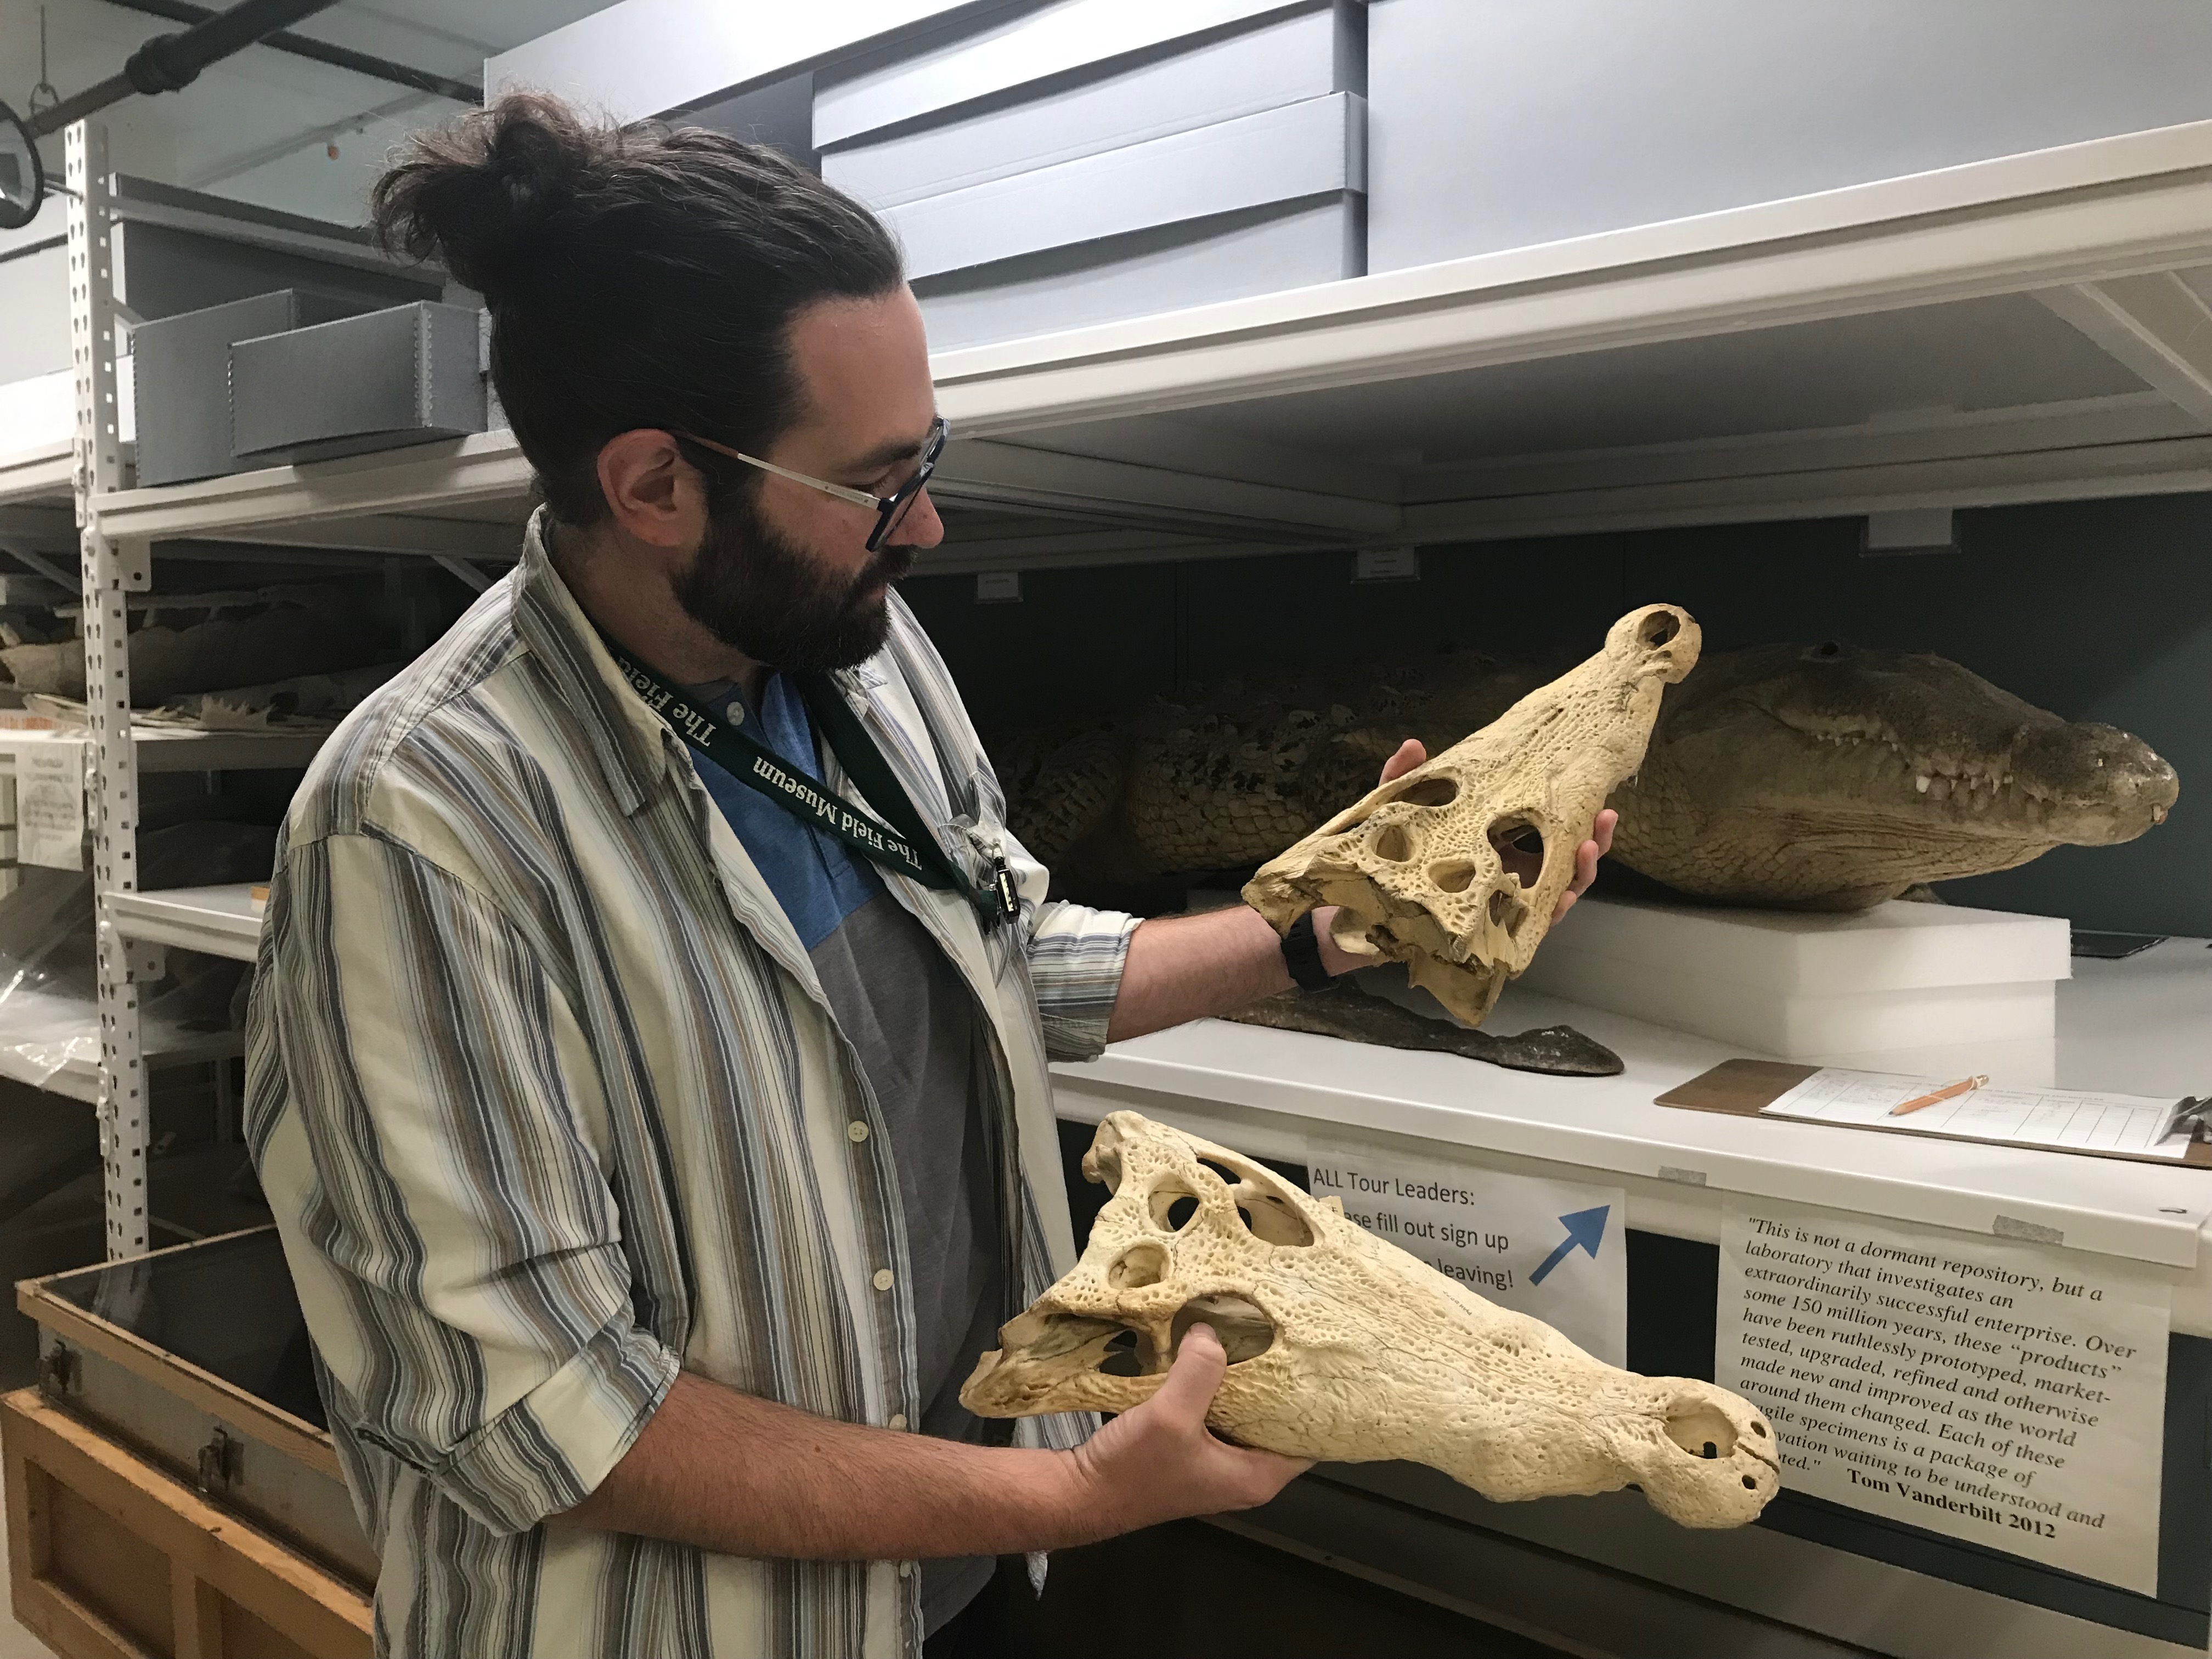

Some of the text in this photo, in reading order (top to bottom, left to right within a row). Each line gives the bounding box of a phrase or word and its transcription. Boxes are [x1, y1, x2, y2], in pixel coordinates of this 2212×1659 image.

[673, 703, 716, 747] The
[753, 756, 922, 871] The Field Museum
[1313, 1167, 1475, 1206] ALL Tour Leaders:
[1344, 1211, 1509, 1254] ase fill out sign up
[1796, 1231, 1809, 1242] is
[1814, 1235, 1839, 1249] not
[1845, 1243, 1855, 1252] a
[1861, 1242, 1936, 1268] dormant
[1943, 1261, 2044, 1292] repository,
[2052, 1277, 2084, 1297] but
[2090, 1289, 2102, 1301] a
[1438, 1258, 1514, 1291] leaving!
[1745, 1268, 2137, 1358] extraordinarily successful enterprise. Over
[1746, 1240, 2013, 1309] laboratory that investigates an
[1743, 1290, 1786, 1306] some
[1792, 1295, 1822, 1314] 150
[1827, 1306, 1887, 1329] million
[1892, 1322, 1945, 1344] years,
[1954, 1332, 2001, 1355] these
[1743, 1307, 2111, 1403] have been ruthlessly prototyped, market-
[1741, 1357, 2077, 1447] made new and improved as the world
[1742, 1333, 2099, 1427] tested, upgraded, refined and otherwise
[1741, 1380, 2066, 1469] around them changed. Each of these
[1749, 1400, 2038, 1488] gile specimens is a package of
[1774, 1431, 2106, 1528] vation waiting to be understood and
[1847, 1468, 2056, 1539] Tom Vanderbilt 2012
